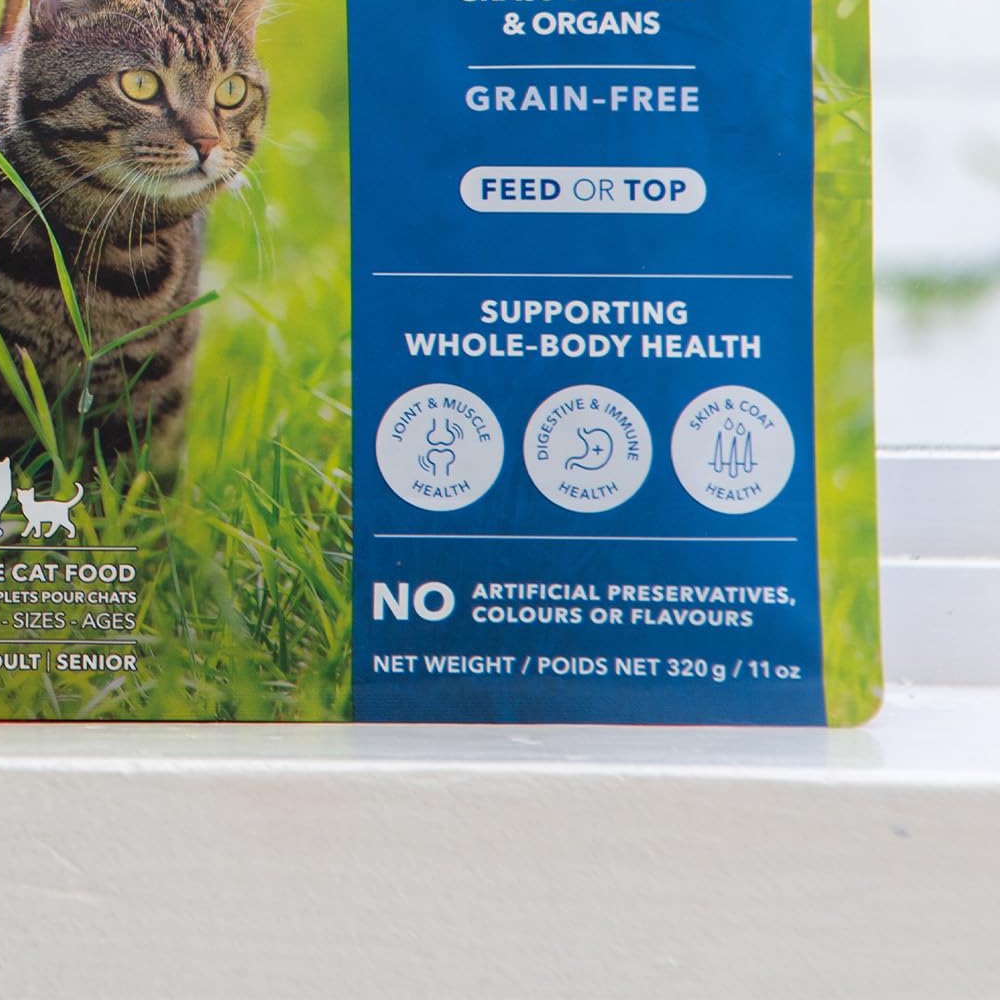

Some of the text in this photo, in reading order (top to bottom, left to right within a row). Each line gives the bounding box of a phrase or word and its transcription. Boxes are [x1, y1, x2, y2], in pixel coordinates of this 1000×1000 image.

[502, 11, 660, 36] & ORGANS
[465, 85, 700, 112] GRAIN-FREE
[480, 178, 687, 202] FEED OR TOP
[480, 300, 688, 325] SUPPORTING
[404, 333, 761, 359] WHOLE-BODY HEALTH
[392, 397, 491, 442] JOINT & MUSCLE
[689, 398, 775, 431] SKIN & COAT
[537, 398, 639, 461] DIGESTIVE & IMMUNE
[412, 480, 471, 498] HEALTH
[558, 481, 619, 500] HEALTH
[705, 482, 761, 501] HEALTH
[11, 563, 58, 582] CAT
[65, 564, 136, 583] FOOD
[41, 591, 84, 603] POUR
[87, 591, 137, 604] CHATS
[372, 580, 455, 622] NO
[472, 583, 796, 606] ARTIFICIAL PRESERVATIVES,
[13, 612, 65, 629] SIZES
[82, 612, 136, 630] AGES
[472, 607, 754, 628] COLOURS OR FLAVOURS
[56, 654, 137, 671] SENIOR
[373, 655, 418, 674] NET
[424, 655, 515, 674] WEIGHT
[538, 656, 608, 676] POIDS
[615, 657, 660, 676] NET
